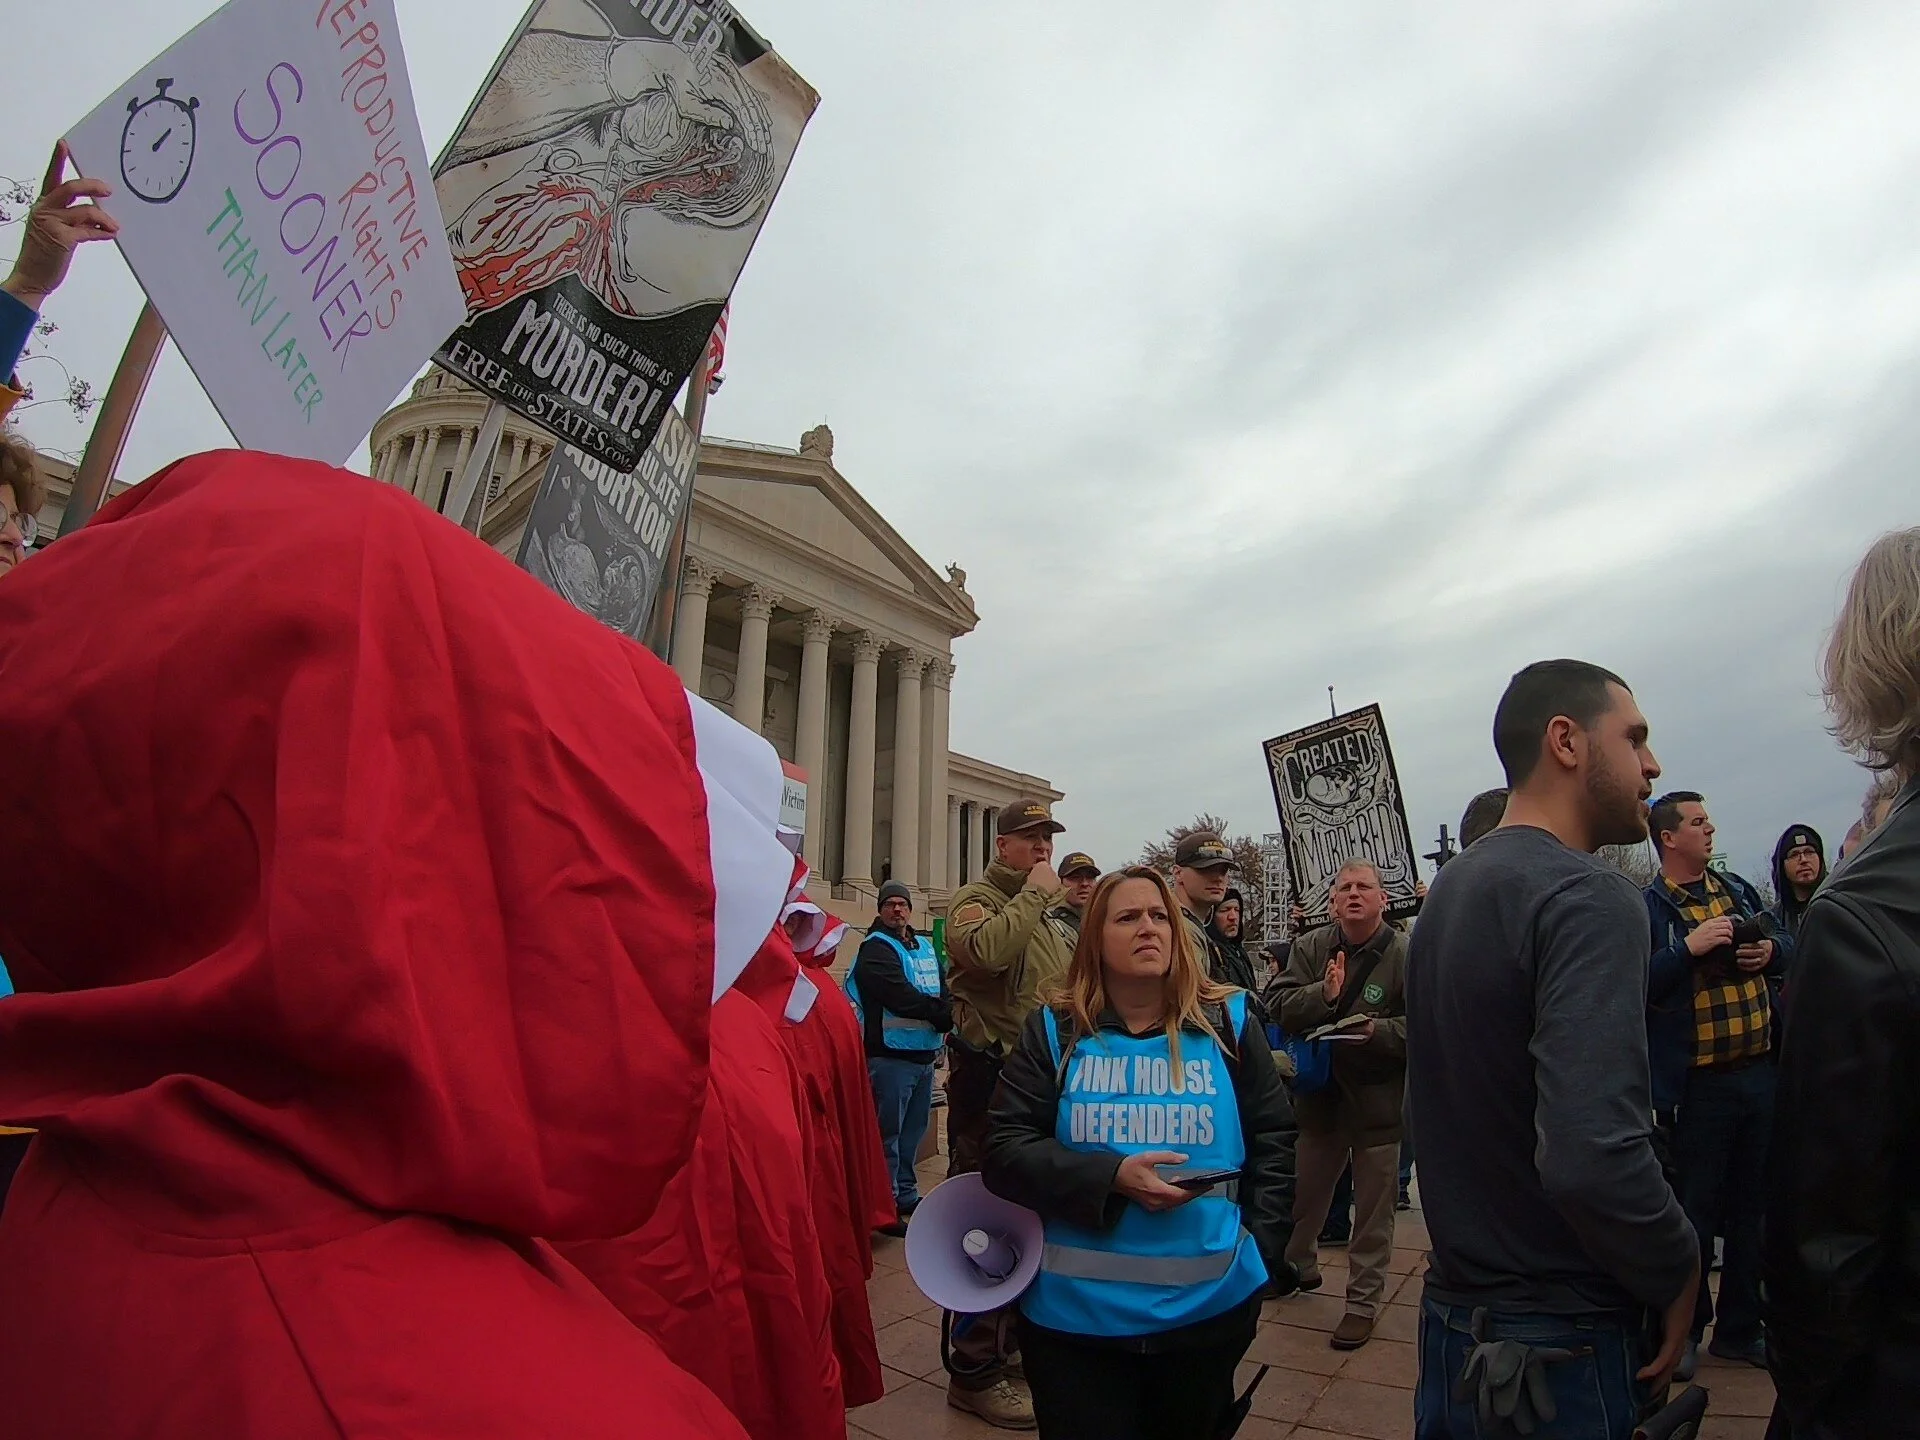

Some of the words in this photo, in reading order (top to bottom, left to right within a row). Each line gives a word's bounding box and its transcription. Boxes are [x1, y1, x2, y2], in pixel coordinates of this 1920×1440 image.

[234, 62, 372, 373] SOONER
[339, 171, 402, 330] RIGHTS
[206, 186, 278, 326] THAN
[261, 312, 324, 424] LATER
[552, 292, 579, 325] THERE
[576, 314, 588, 333] IS
[585, 322, 602, 343] NO
[600, 332, 630, 358] SUCH
[627, 349, 659, 378] THING
[656, 368, 674, 386] AS
[448, 340, 513, 394] FREE
[511, 381, 535, 402] THE
[501, 299, 663, 439] MURDER!
[653, 410, 697, 487] ISH
[1282, 728, 1375, 805] CREATED
[1305, 915, 1330, 926] ABOLI
[1394, 899, 1417, 911] NOW
[1133, 1055, 1217, 1096] HOUSE
[1070, 1102, 1215, 1146] DEFENDERS
